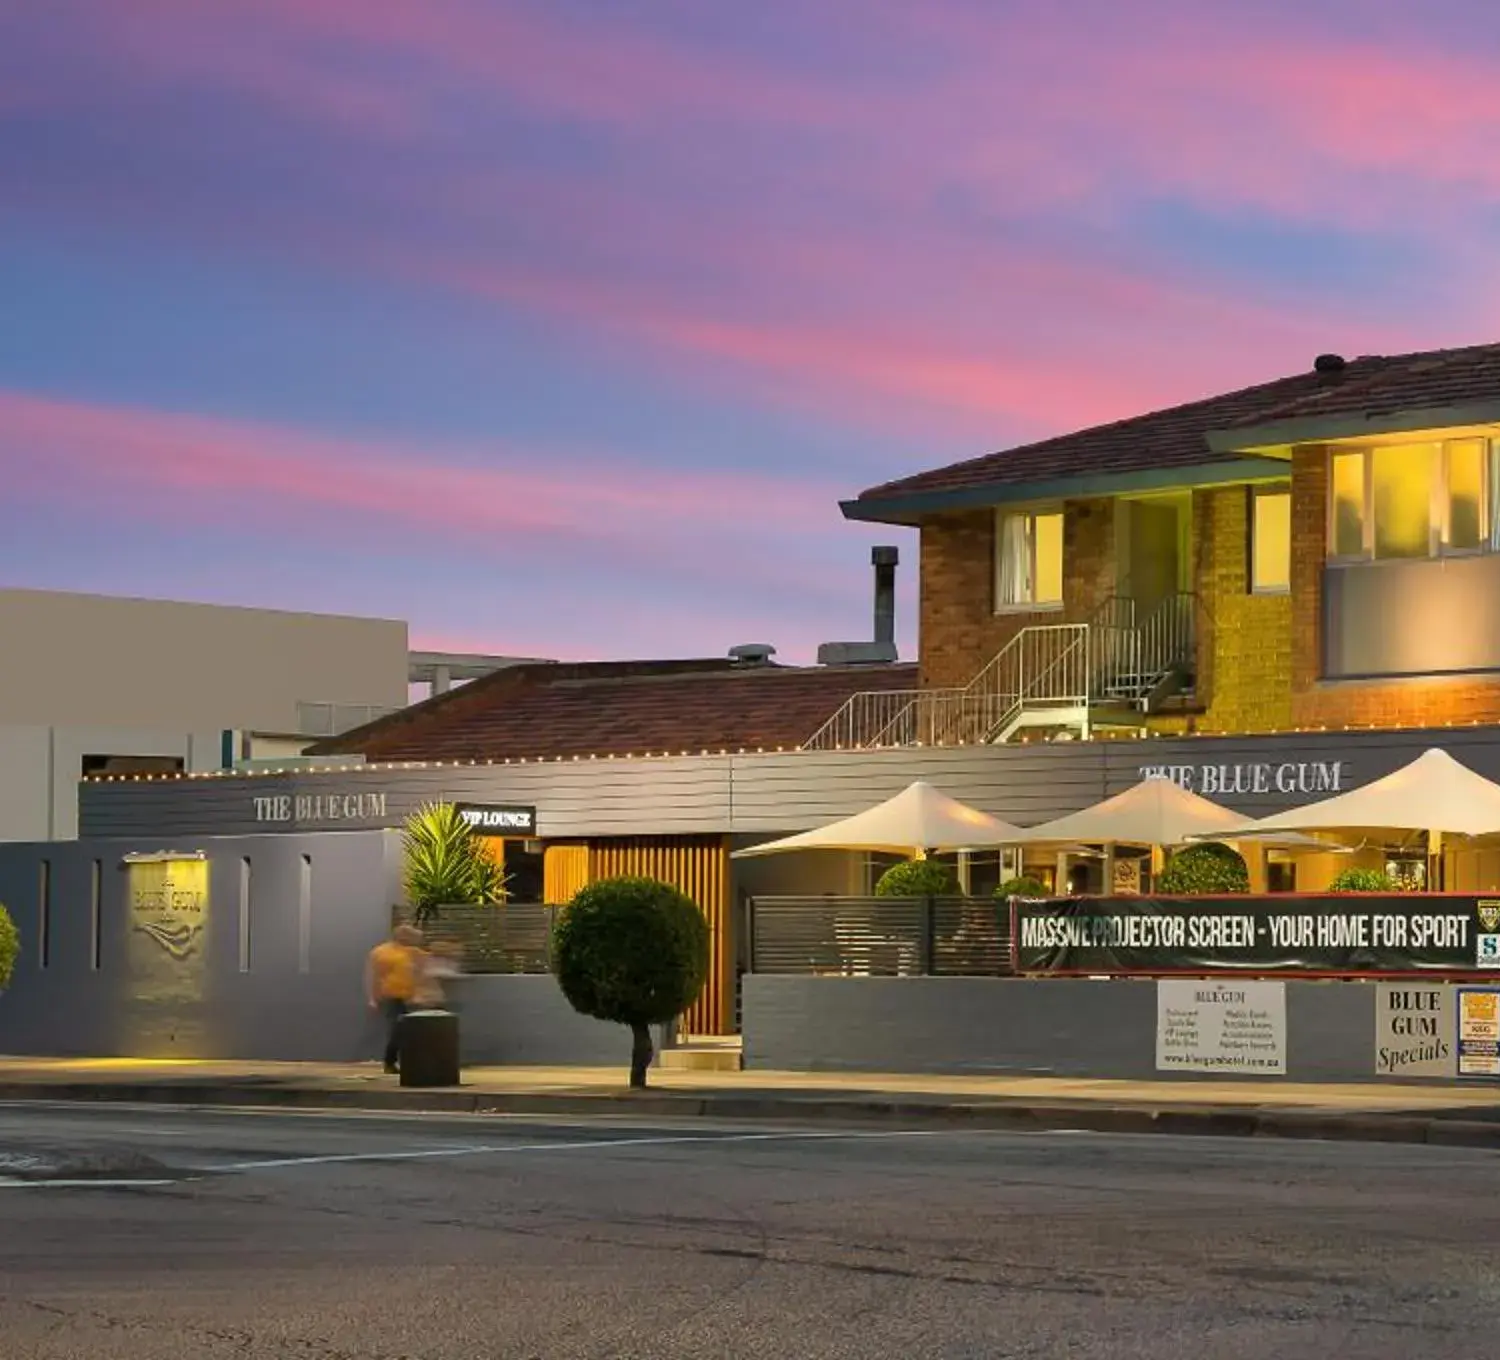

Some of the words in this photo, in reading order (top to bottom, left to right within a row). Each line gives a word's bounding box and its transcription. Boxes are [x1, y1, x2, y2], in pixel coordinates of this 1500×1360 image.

[1201, 764, 1270, 793] BLUE
[1274, 761, 1342, 793] GUM
[253, 796, 291, 821] THE
[295, 794, 341, 820] BLUE
[342, 792, 387, 819] GUM
[461, 811, 482, 825] VIP
[483, 811, 531, 827] LOUNGE
[1021, 917, 1091, 947] MASSIVE
[1093, 916, 1185, 947] PROJECTOR
[1187, 916, 1255, 948] SCREEN
[1268, 915, 1314, 947] YOUR
[1317, 915, 1369, 947] HOME
[1373, 915, 1407, 947] FOR
[1411, 915, 1470, 947] SPORT
[1389, 991, 1440, 1011] BLUE
[1391, 1016, 1438, 1036] GUM
[1377, 1038, 1449, 1072] Specials
